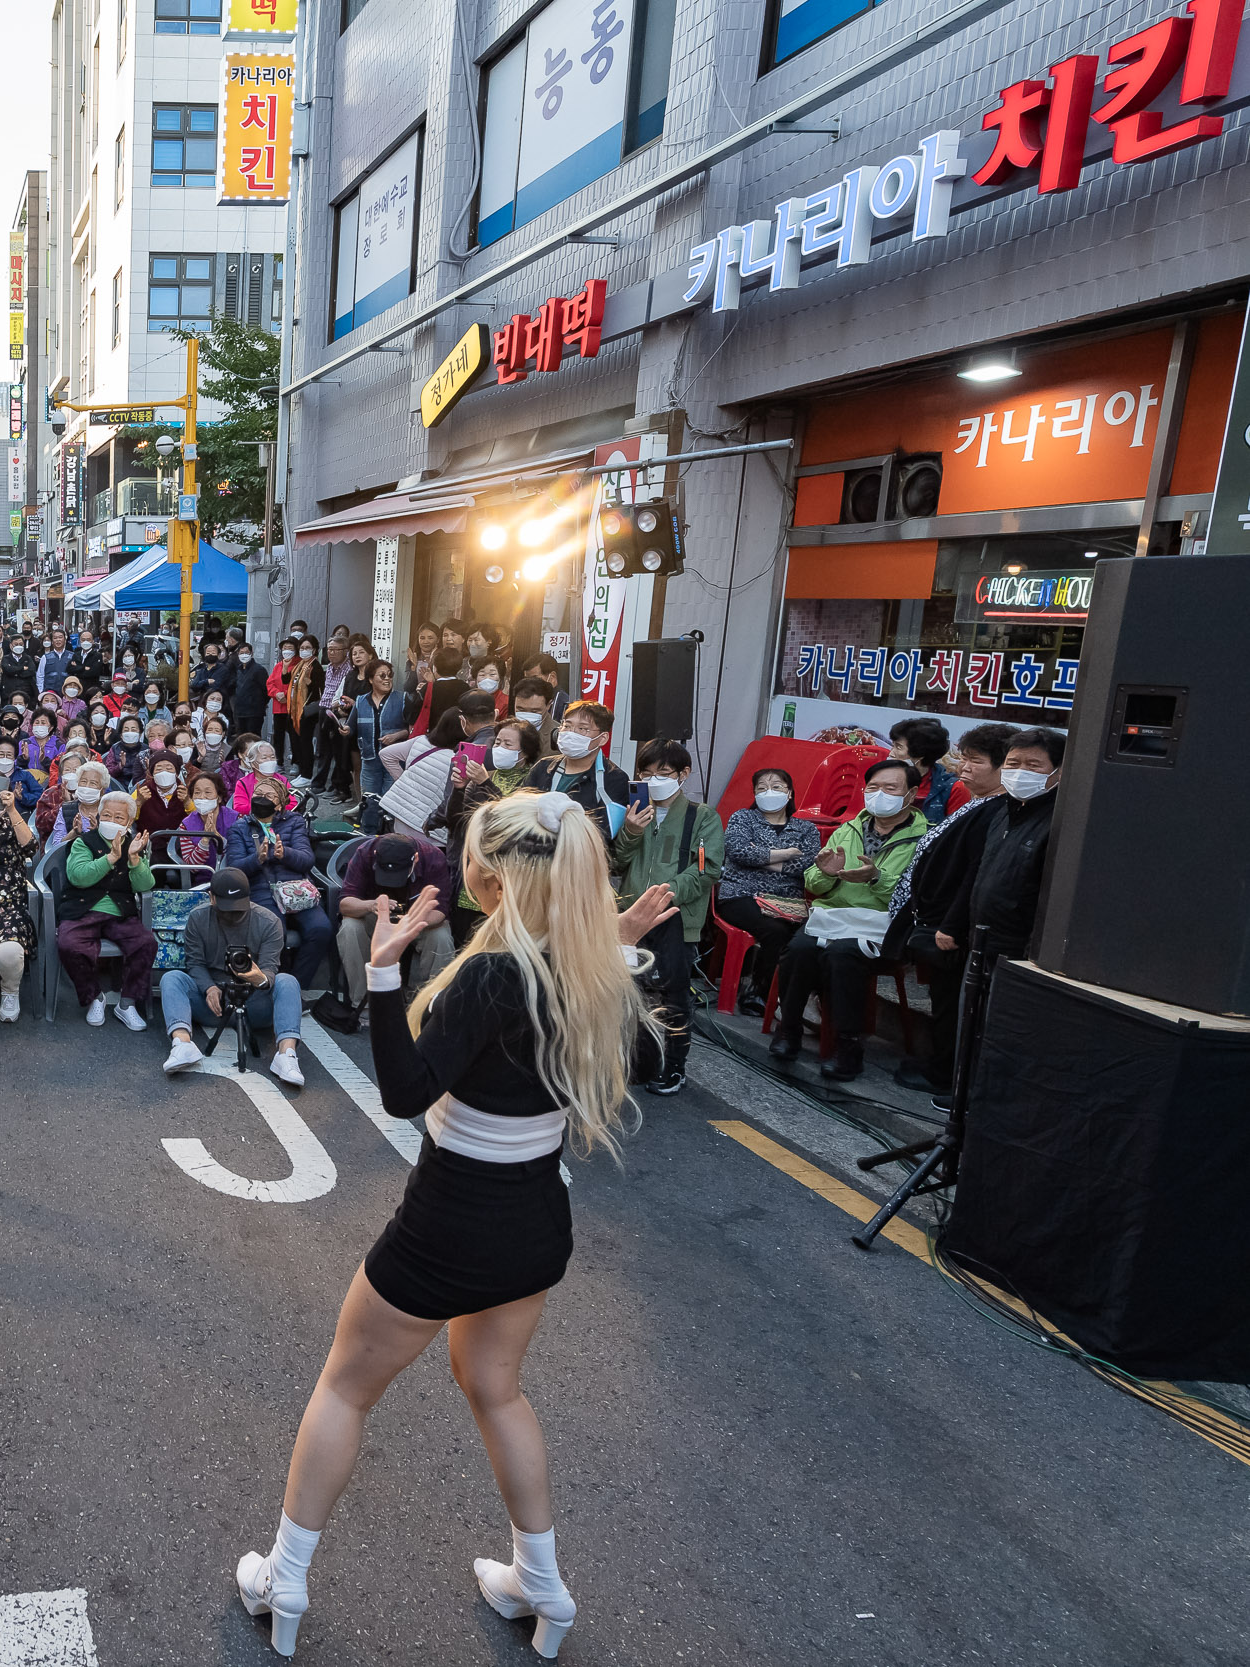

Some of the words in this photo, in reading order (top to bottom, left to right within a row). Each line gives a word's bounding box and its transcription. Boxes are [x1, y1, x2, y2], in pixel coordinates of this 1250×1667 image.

[231, 66, 292, 86] 카나리아
[974, 0, 1245, 195] 치킨
[239, 95, 278, 190] 치킨
[364, 175, 409, 228] 대한예수교
[683, 130, 965, 312] 카나리아
[11, 255, 23, 302] 마사지
[493, 279, 607, 385] 빈대떡
[431, 343, 469, 406] 정가네
[109, 413, 130, 423] CCTV
[131, 410, 153, 422] 작동중
[953, 383, 1159, 468] 카나리아
[67, 574, 75, 583] P
